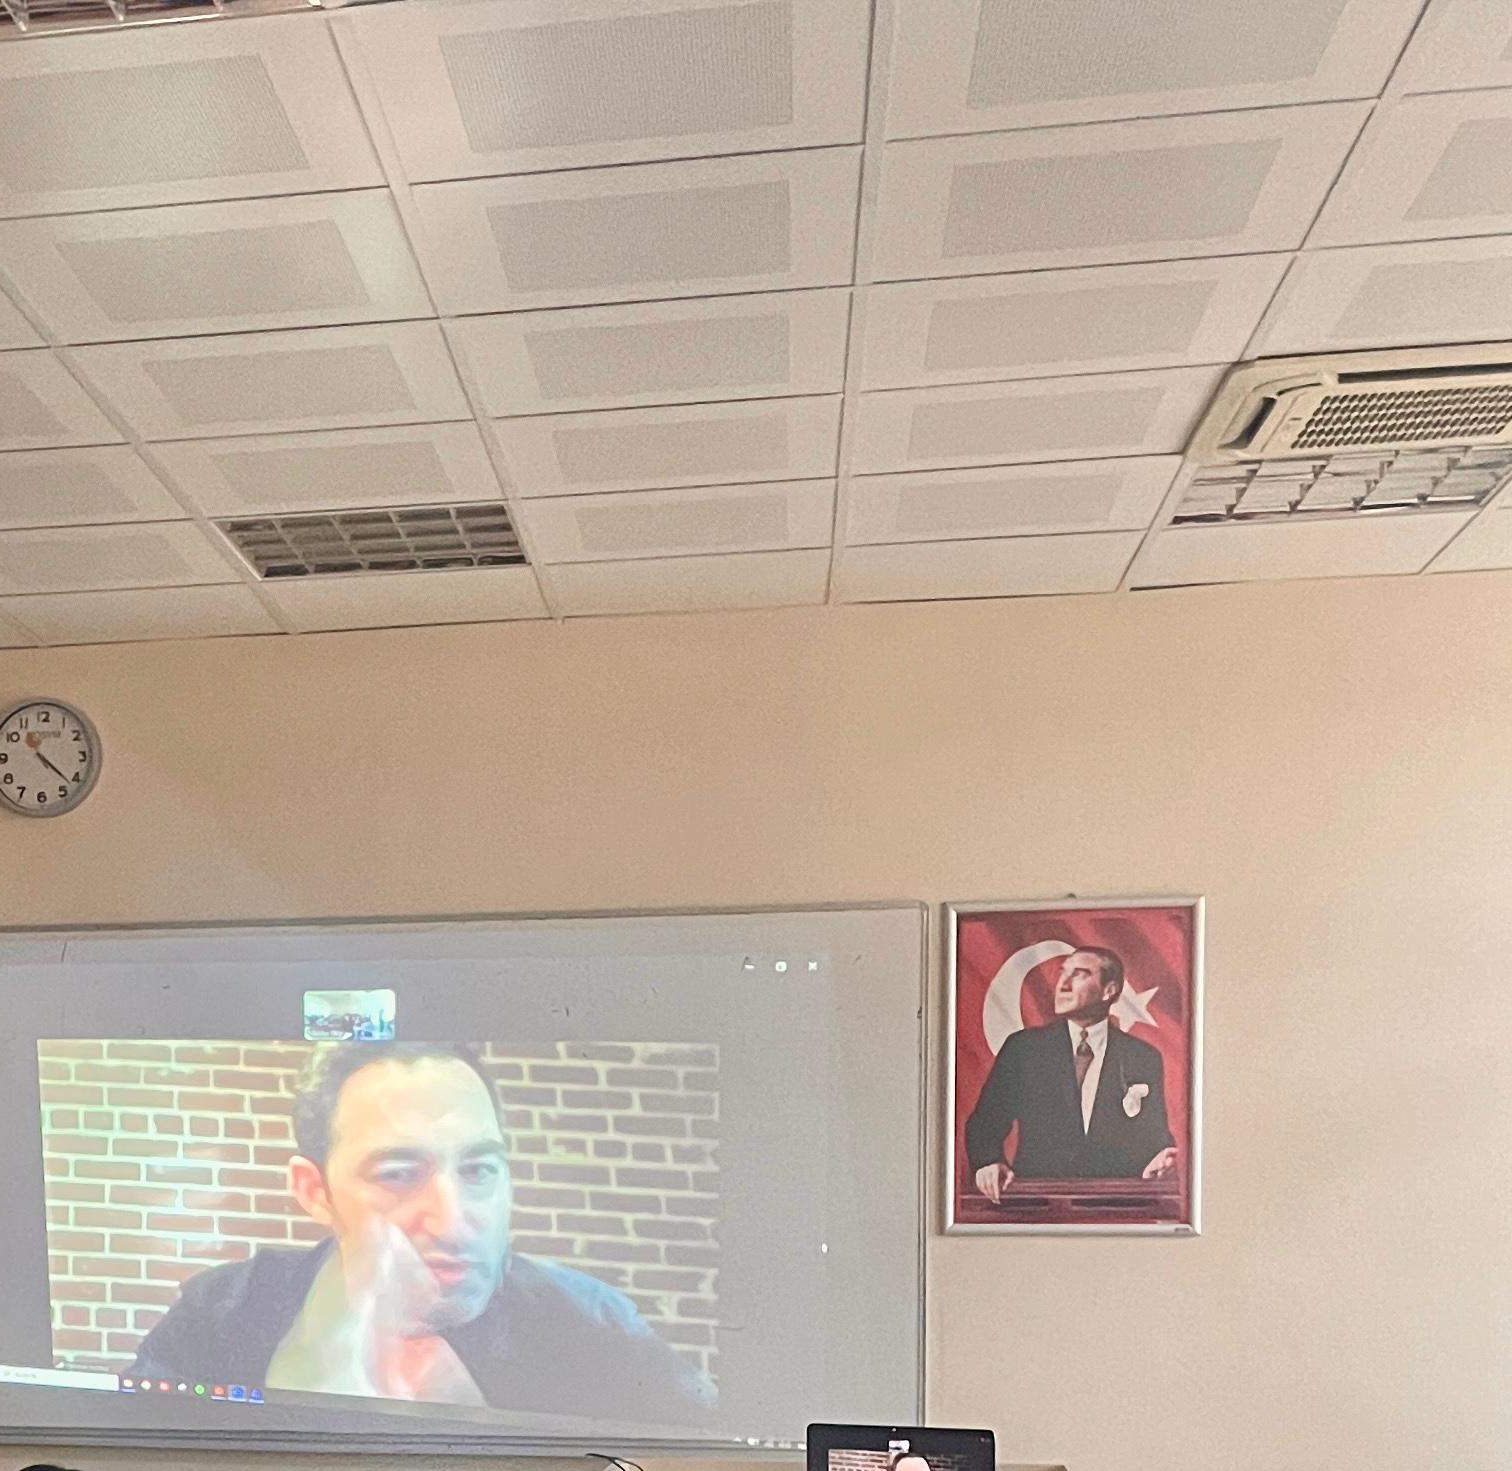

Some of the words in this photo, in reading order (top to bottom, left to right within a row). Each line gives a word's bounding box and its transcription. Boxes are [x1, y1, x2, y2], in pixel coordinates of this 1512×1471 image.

[37, 711, 50, 722] 12
[7, 731, 20, 743] 10
[72, 730, 81, 741] 2
[78, 751, 87, 763] 3
[3, 773, 14, 784] 8
[72, 771, 81, 783] 4
[17, 786, 26, 799] 7
[37, 792, 47, 803] 6
[58, 786, 68, 798] 5
